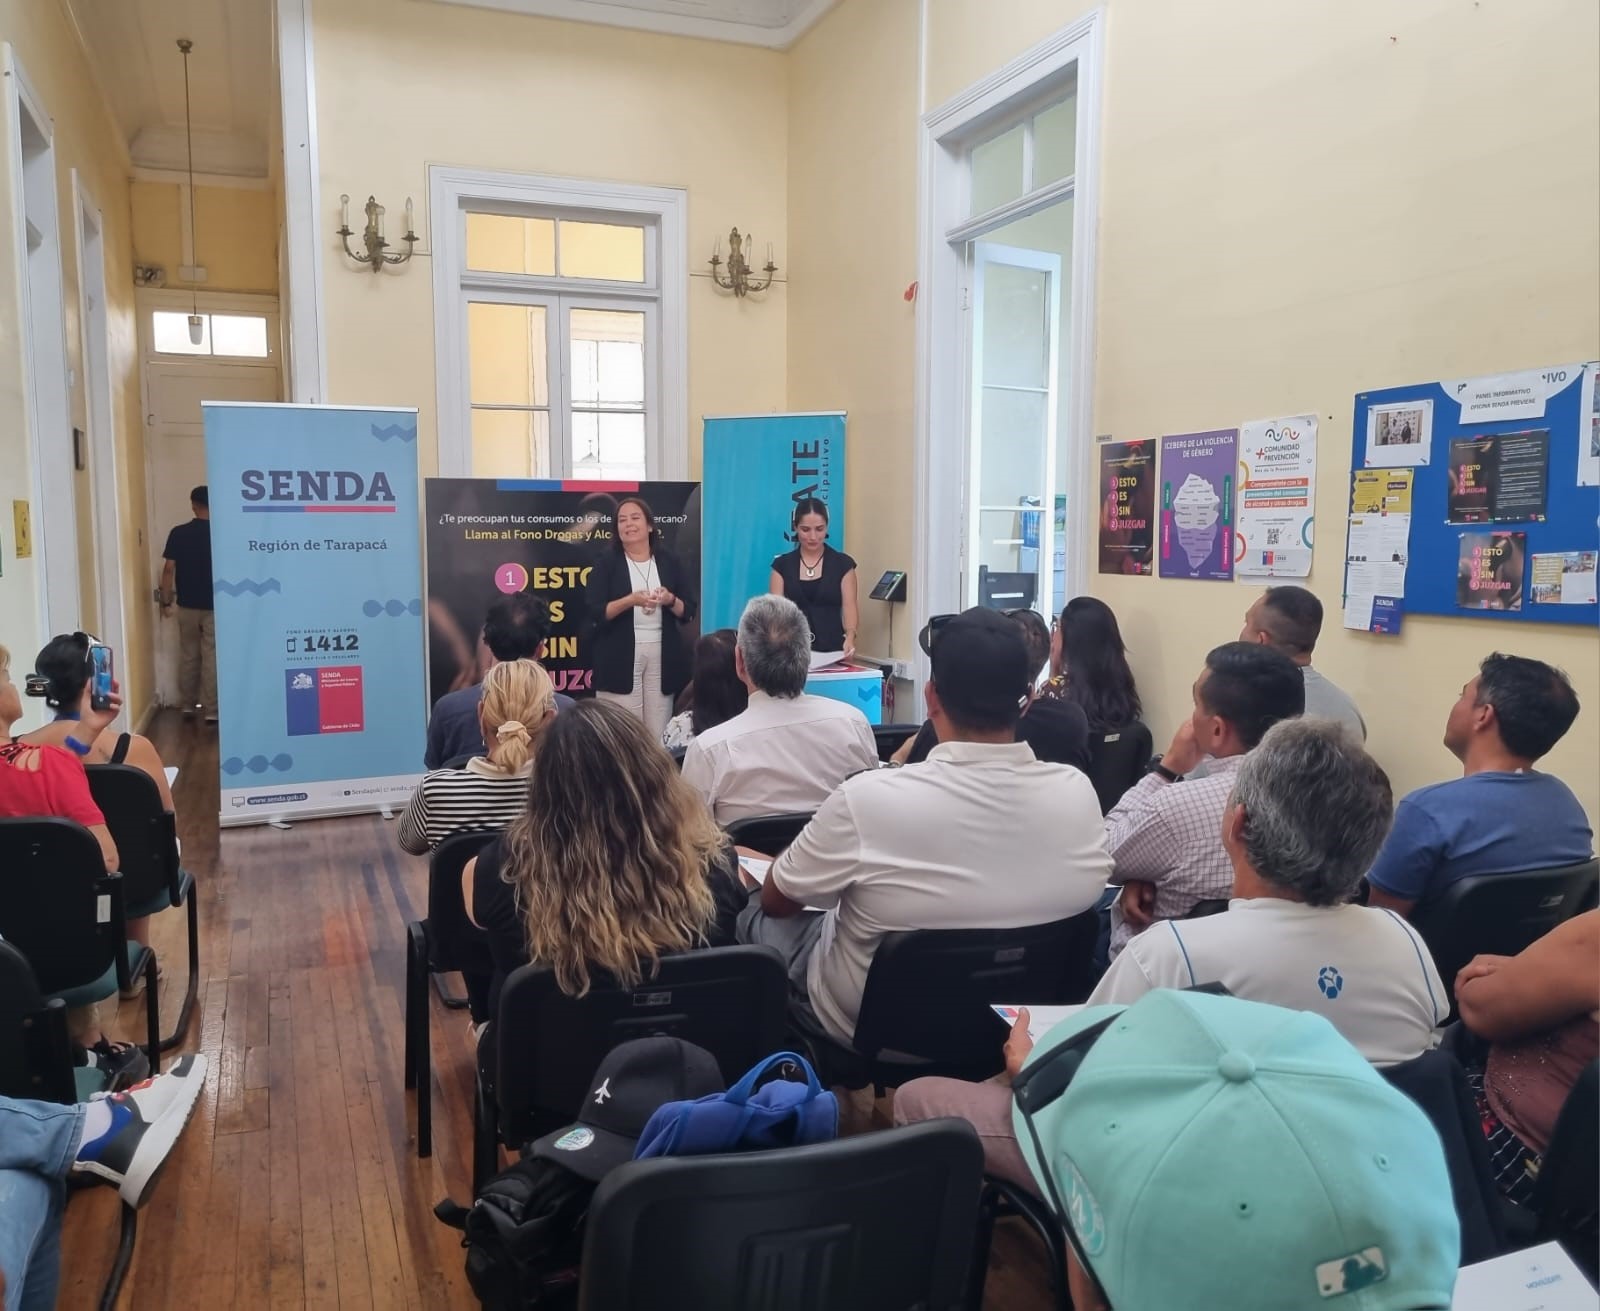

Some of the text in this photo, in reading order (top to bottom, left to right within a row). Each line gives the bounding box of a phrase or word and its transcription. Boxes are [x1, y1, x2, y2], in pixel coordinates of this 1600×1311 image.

[1547, 371, 1567, 383] IVO
[1492, 388, 1531, 397] INFORMATIVO
[1165, 441, 1187, 450] ICEBERG
[1188, 440, 1195, 448] DE
[1204, 436, 1234, 446] VIOLENCIA
[1264, 443, 1300, 452] COMUNIDAD
[1183, 448, 1213, 458] DE GÉNERO
[1264, 453, 1300, 461] PREVENCIÓN
[241, 470, 396, 501] SENDA
[1119, 477, 1137, 487] ESTO
[1119, 492, 1128, 501] ES
[1118, 506, 1130, 516] SIN
[440, 514, 688, 525] ¿Te preocupan tus consumos o los de ercano?
[1118, 520, 1146, 529] JUZGAR
[464, 529, 613, 542] Llama al Fono Drogas y Alc
[248, 538, 388, 553] Región de Tarapacá
[1482, 548, 1503, 556] ESTO
[1482, 559, 1492, 567] ES
[505, 570, 516, 586] 1
[1480, 571, 1494, 579] SIN
[548, 600, 566, 622] S
[304, 634, 359, 652] 1412
